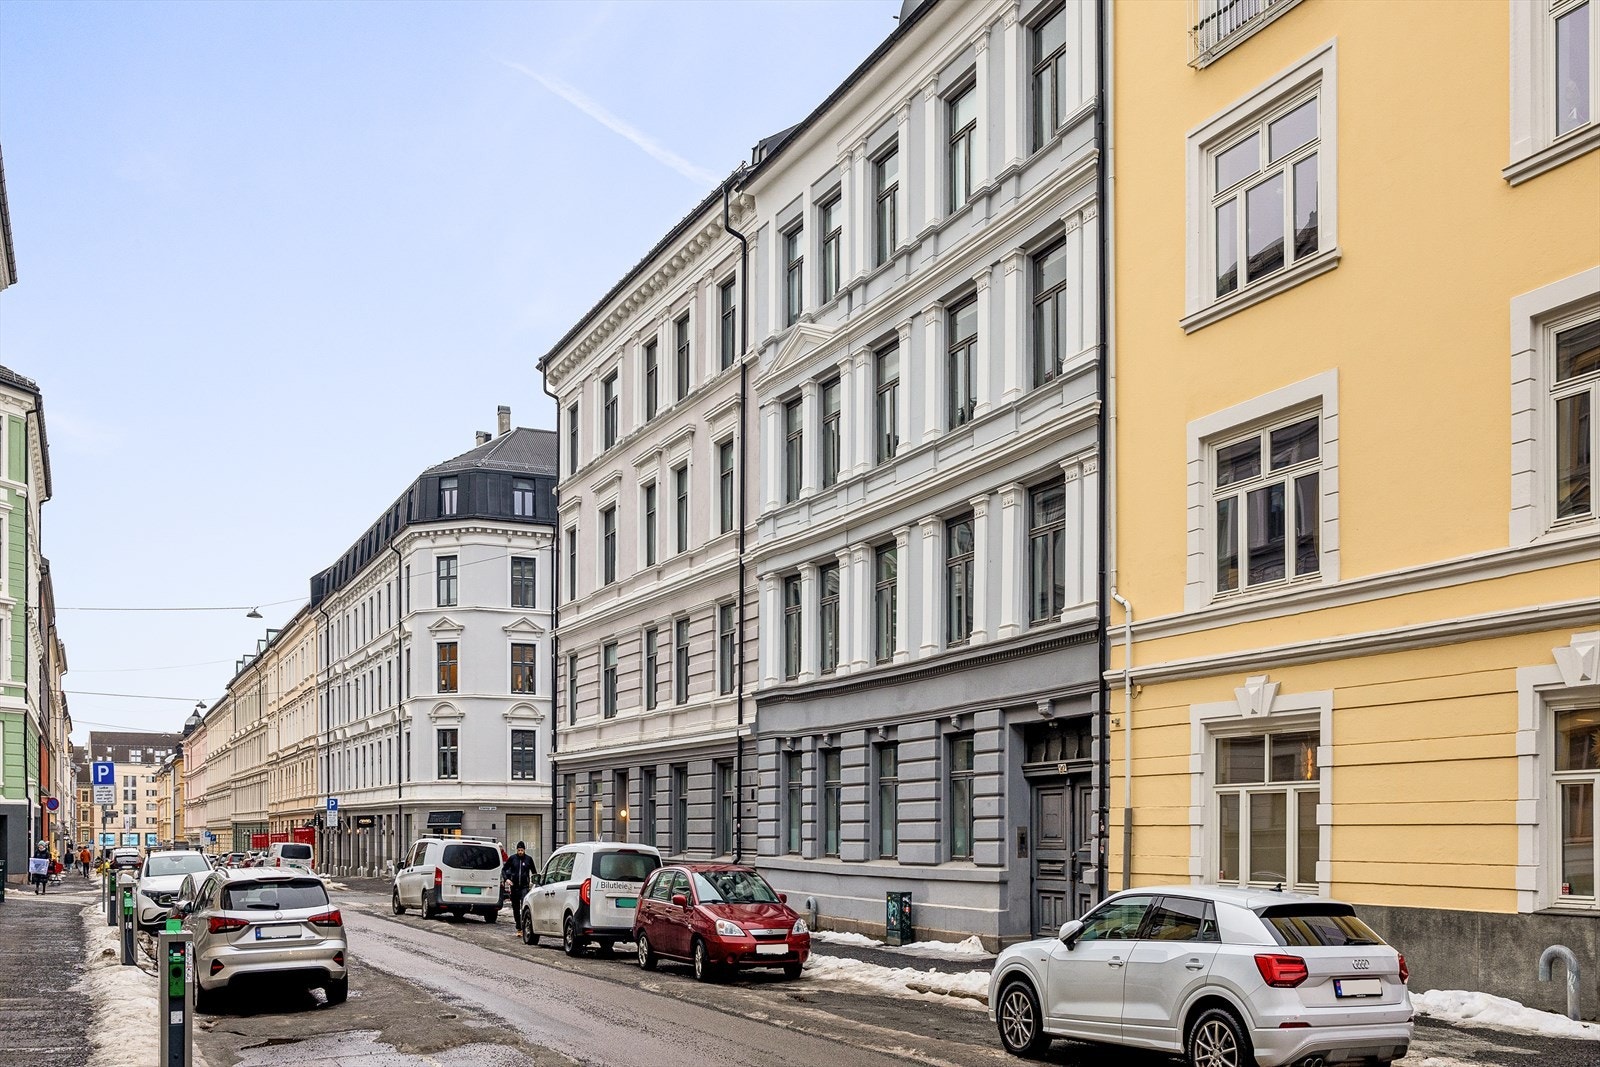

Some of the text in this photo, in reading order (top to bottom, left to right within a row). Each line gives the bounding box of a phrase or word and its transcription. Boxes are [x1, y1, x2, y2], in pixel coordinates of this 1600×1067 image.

[98, 765, 109, 782] P
[329, 799, 336, 809] P
[601, 881, 627, 889] Bilutleie
